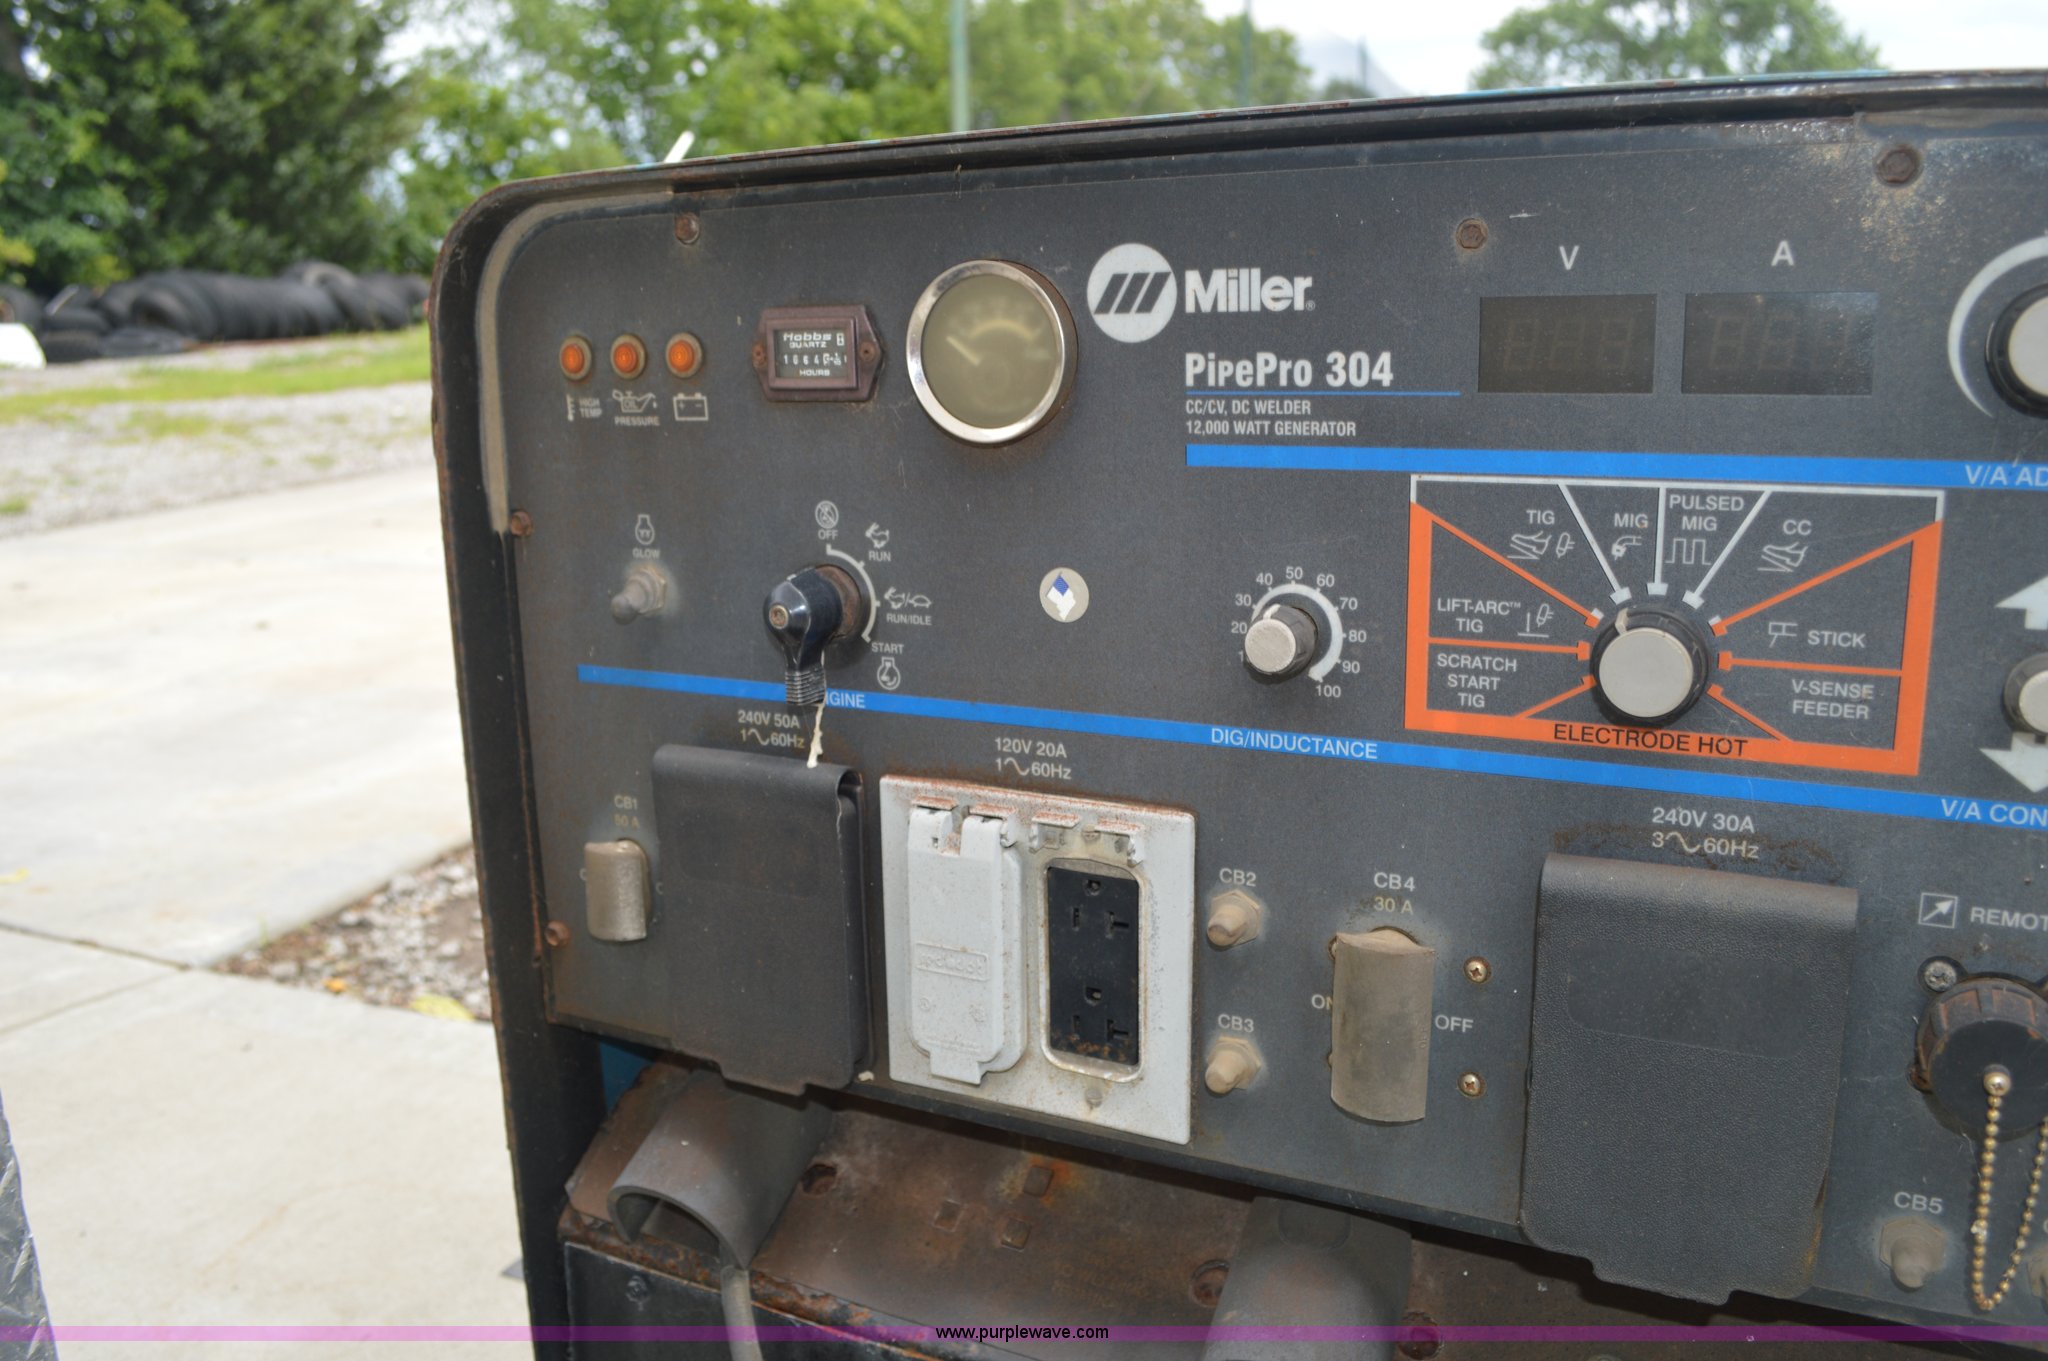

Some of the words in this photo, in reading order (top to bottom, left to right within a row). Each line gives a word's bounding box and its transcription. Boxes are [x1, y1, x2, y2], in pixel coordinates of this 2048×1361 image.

[1559, 245, 1579, 271] V
[1771, 240, 1795, 267] A
[783, 332, 832, 342] Hobbs
[789, 341, 827, 349] QUARTZ
[1185, 352, 1312, 387] PipePro
[1326, 351, 1394, 387] 304
[579, 398, 600, 408] HIGH
[1186, 399, 1228, 416] CC/CV,
[1232, 400, 1250, 415] DC
[1253, 400, 1311, 415] WELDER
[580, 408, 602, 418] TEMP
[614, 416, 660, 426] PRESSURE
[1186, 420, 1230, 437] 12,000
[1233, 421, 1270, 436] WATT
[1274, 421, 1357, 437] GENERATOR
[1964, 463, 2008, 487] V/A
[1669, 494, 1744, 511] PULSED
[1526, 509, 1555, 525] TIG
[1614, 513, 1649, 528] MIG
[1682, 515, 1718, 532] MIG
[817, 529, 839, 542] OFF
[1783, 519, 1812, 536] CC
[632, 547, 660, 560] GLOW
[868, 550, 892, 562] RUN
[1256, 573, 1273, 586] 40
[1286, 566, 1303, 580] 50
[1317, 574, 1335, 588] 60
[1235, 594, 1252, 606] 30
[1339, 597, 1358, 610] 70
[886, 613, 932, 626] RUN/IDLE
[1231, 622, 1247, 634] 20
[1456, 617, 1484, 633] TIG
[1348, 630, 1367, 643] 80
[1807, 630, 1866, 648] STICK
[871, 642, 904, 655] START
[1342, 661, 1360, 674] 90
[1437, 653, 1517, 673] SCRATCH
[1315, 684, 1341, 698] 100
[1447, 674, 1500, 691] START
[1791, 678, 1875, 700] V-SENSE
[1458, 692, 1485, 708] TIG
[1792, 700, 1869, 720] FEEDER
[737, 709, 771, 726] 240V
[774, 713, 800, 729] 50A
[995, 737, 1032, 755] 120V
[1036, 741, 1067, 758] 20A
[1211, 728, 1378, 760] DIG/INDUCTANCE
[1553, 723, 1690, 752] ELECTRODE
[1698, 735, 1748, 756] HOT
[614, 794, 638, 810] CB1
[1941, 797, 1982, 820] V/A
[1652, 806, 1708, 828] 240V
[1712, 813, 1755, 834] 30A
[1219, 867, 1257, 888] CB2
[1373, 871, 1416, 893] CB4
[1373, 896, 1396, 913] 30
[1401, 900, 1414, 916] A
[1217, 1013, 1254, 1033] CB3
[1434, 1014, 1474, 1034] OFF
[1894, 1190, 1943, 1216] CB5
